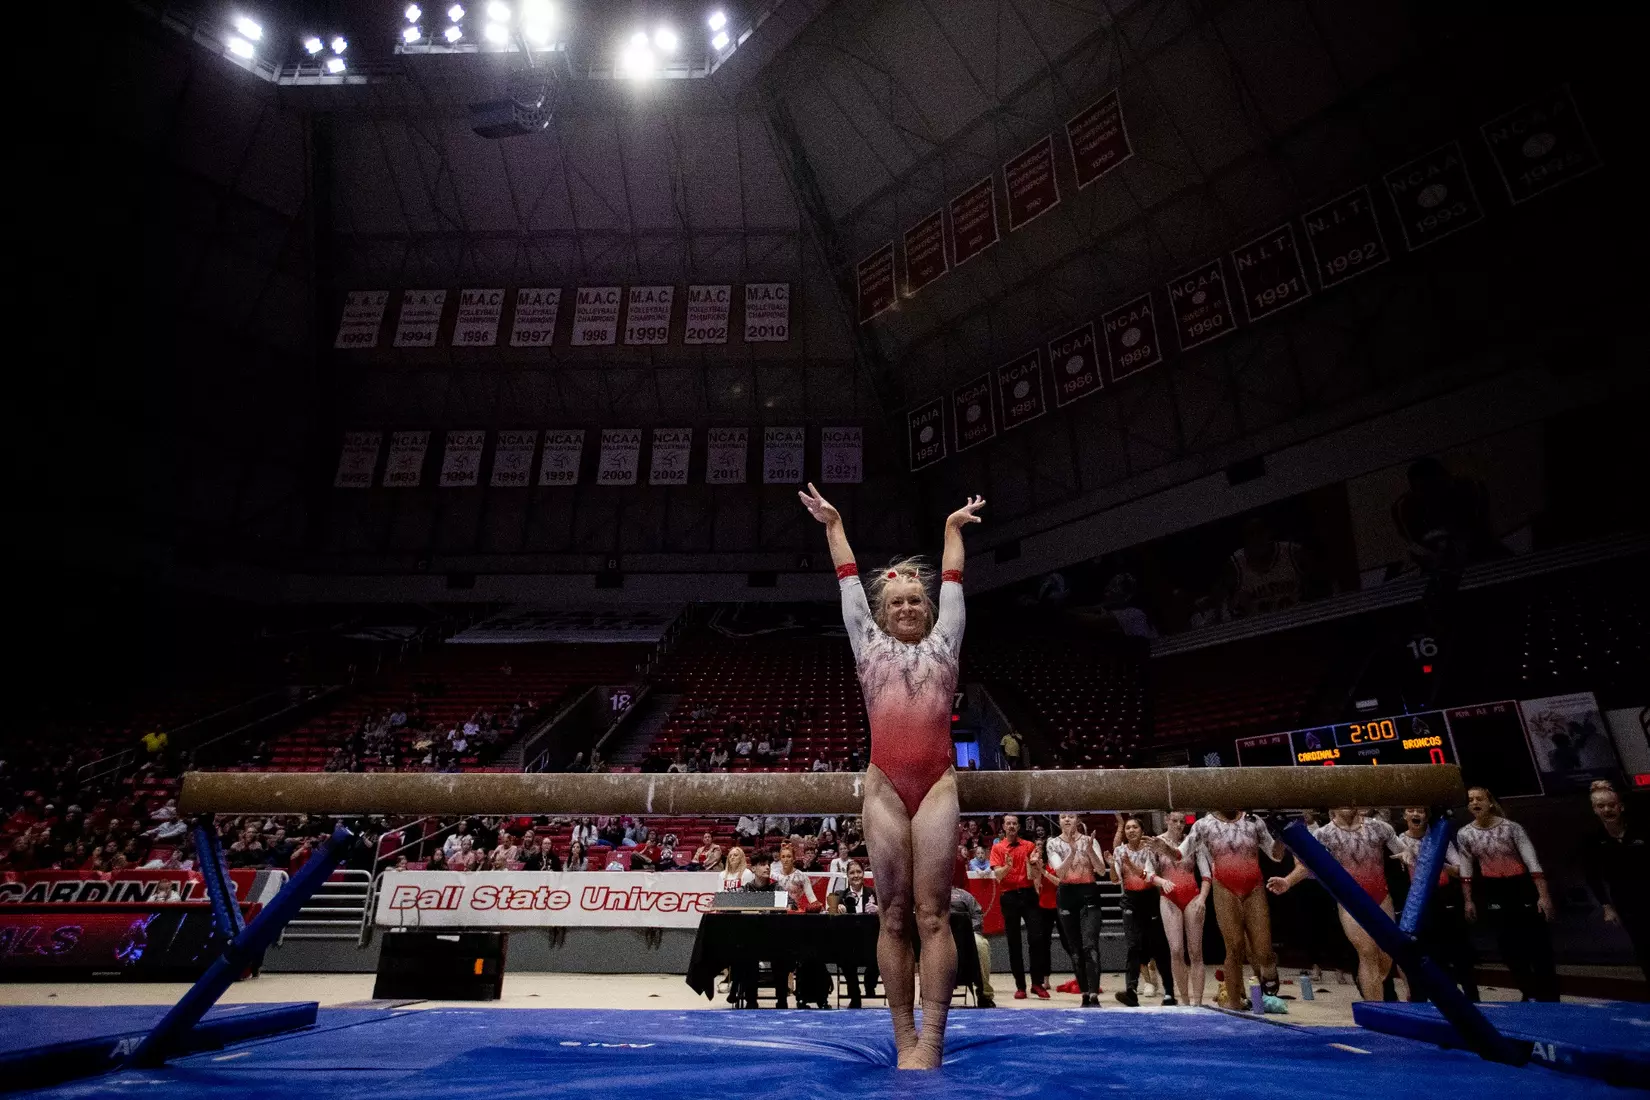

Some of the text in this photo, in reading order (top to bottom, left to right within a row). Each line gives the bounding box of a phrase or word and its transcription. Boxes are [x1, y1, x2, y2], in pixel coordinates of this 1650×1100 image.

[1391, 154, 1458, 195] NCAA
[1416, 201, 1468, 232] 1993
[1325, 241, 1379, 275] 1992
[1172, 270, 1220, 300] NCAA
[577, 292, 618, 304] M.A.C.
[631, 291, 670, 303] M.A.C.
[689, 290, 728, 302] M.A.C.
[747, 287, 787, 300] M.A.C.
[1254, 277, 1299, 308] 1991
[461, 293, 502, 305] M.A.C.
[517, 293, 558, 305] M.A.C.
[1107, 306, 1150, 333] NCAA
[1188, 314, 1223, 337] 1990
[402, 332, 432, 341] 1994
[516, 331, 550, 341] 1997
[628, 327, 667, 340] 1999
[687, 327, 726, 339] 2002
[748, 325, 786, 337] 2010
[1053, 334, 1092, 360] NCAA
[1119, 345, 1150, 368] 1989
[1001, 360, 1037, 385] NCAA
[1011, 397, 1036, 416] 1981
[913, 408, 940, 428] NAIA
[447, 435, 483, 444] NCAA
[497, 435, 535, 444] NCAA
[545, 434, 583, 444] NCAA
[602, 434, 639, 443] NCAA
[653, 433, 691, 442] NCAA
[709, 432, 746, 442] NCAA
[765, 432, 802, 441] NCAA
[823, 432, 860, 441] NCAA
[602, 470, 632, 480] 2000
[653, 470, 684, 479] 2002
[713, 469, 740, 479] 2011
[768, 469, 799, 479] 2019
[1407, 637, 1438, 659] 16
[1349, 720, 1395, 743] 2:00
[1402, 736, 1442, 749] BRONCOS
[1298, 748, 1340, 762] CARDINALS
[389, 885, 465, 910] Ball
[470, 885, 571, 911] State
